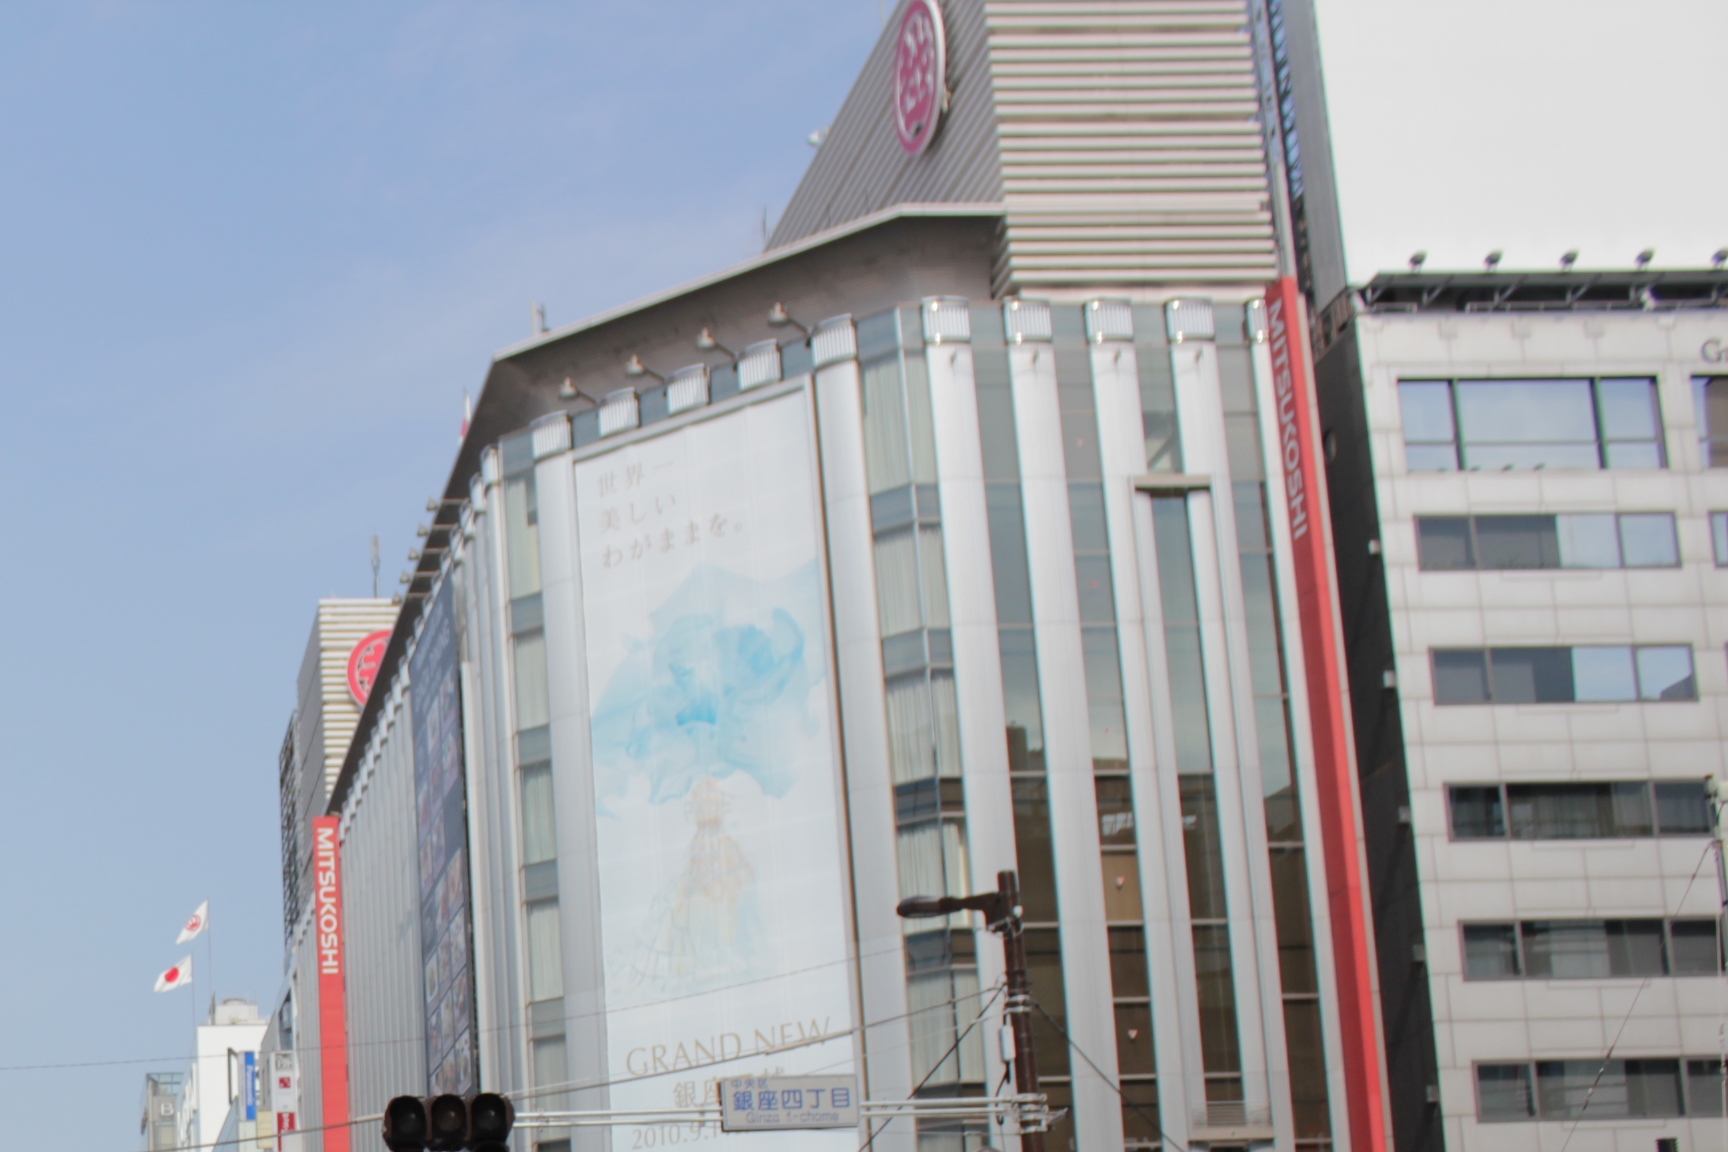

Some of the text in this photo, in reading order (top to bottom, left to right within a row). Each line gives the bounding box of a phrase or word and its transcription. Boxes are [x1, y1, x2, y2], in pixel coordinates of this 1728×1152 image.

[1269, 299, 1307, 540] MITSUKOSHI
[598, 460, 674, 498] 世界一
[600, 494, 676, 535] 美しい
[602, 513, 742, 569] わがままを。
[317, 827, 339, 974] MITSUKOSHI
[626, 1016, 830, 1078] GRAND NEW
[732, 1078, 768, 1089] 中央区
[733, 1087, 851, 1111] 銀座四丁目
[746, 1111, 839, 1124] Ginza 4-chome
